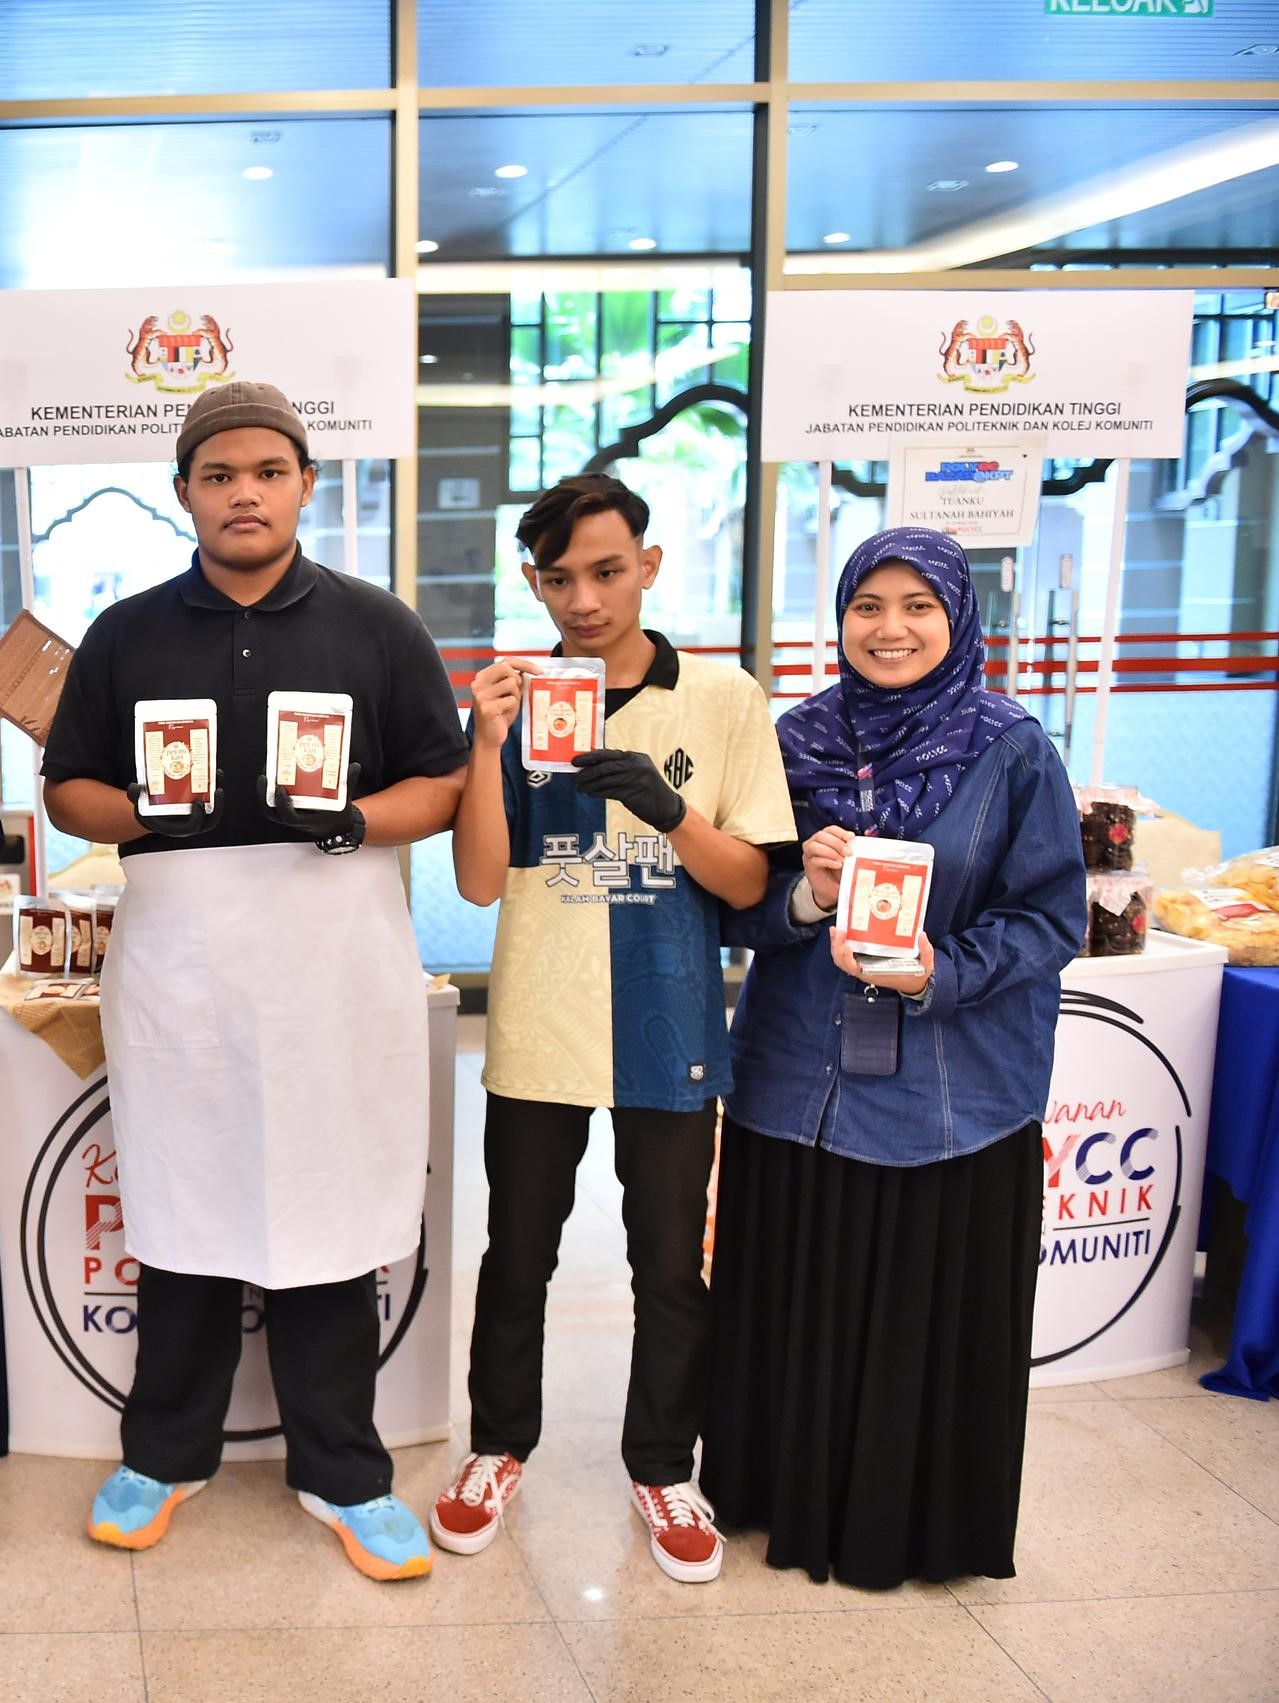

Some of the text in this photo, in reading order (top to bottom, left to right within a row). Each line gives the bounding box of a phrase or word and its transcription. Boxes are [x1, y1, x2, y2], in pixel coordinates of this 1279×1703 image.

[31, 404, 158, 420] KEMENTERIAN
[848, 402, 1121, 417] KEMENTERIAN PENDIDIKAN TINGGI
[53, 424, 137, 436] PENDIDIKAN
[307, 420, 372, 431] KOMUNITI
[805, 420, 1153, 434] JABATAN PENDIDIKAN POLITEKNIK DAN KOLEJ KOMUNITI
[539, 832, 677, 889] 풋살팬
[592, 893, 625, 903] BAYAR
[626, 893, 656, 905] COURT
